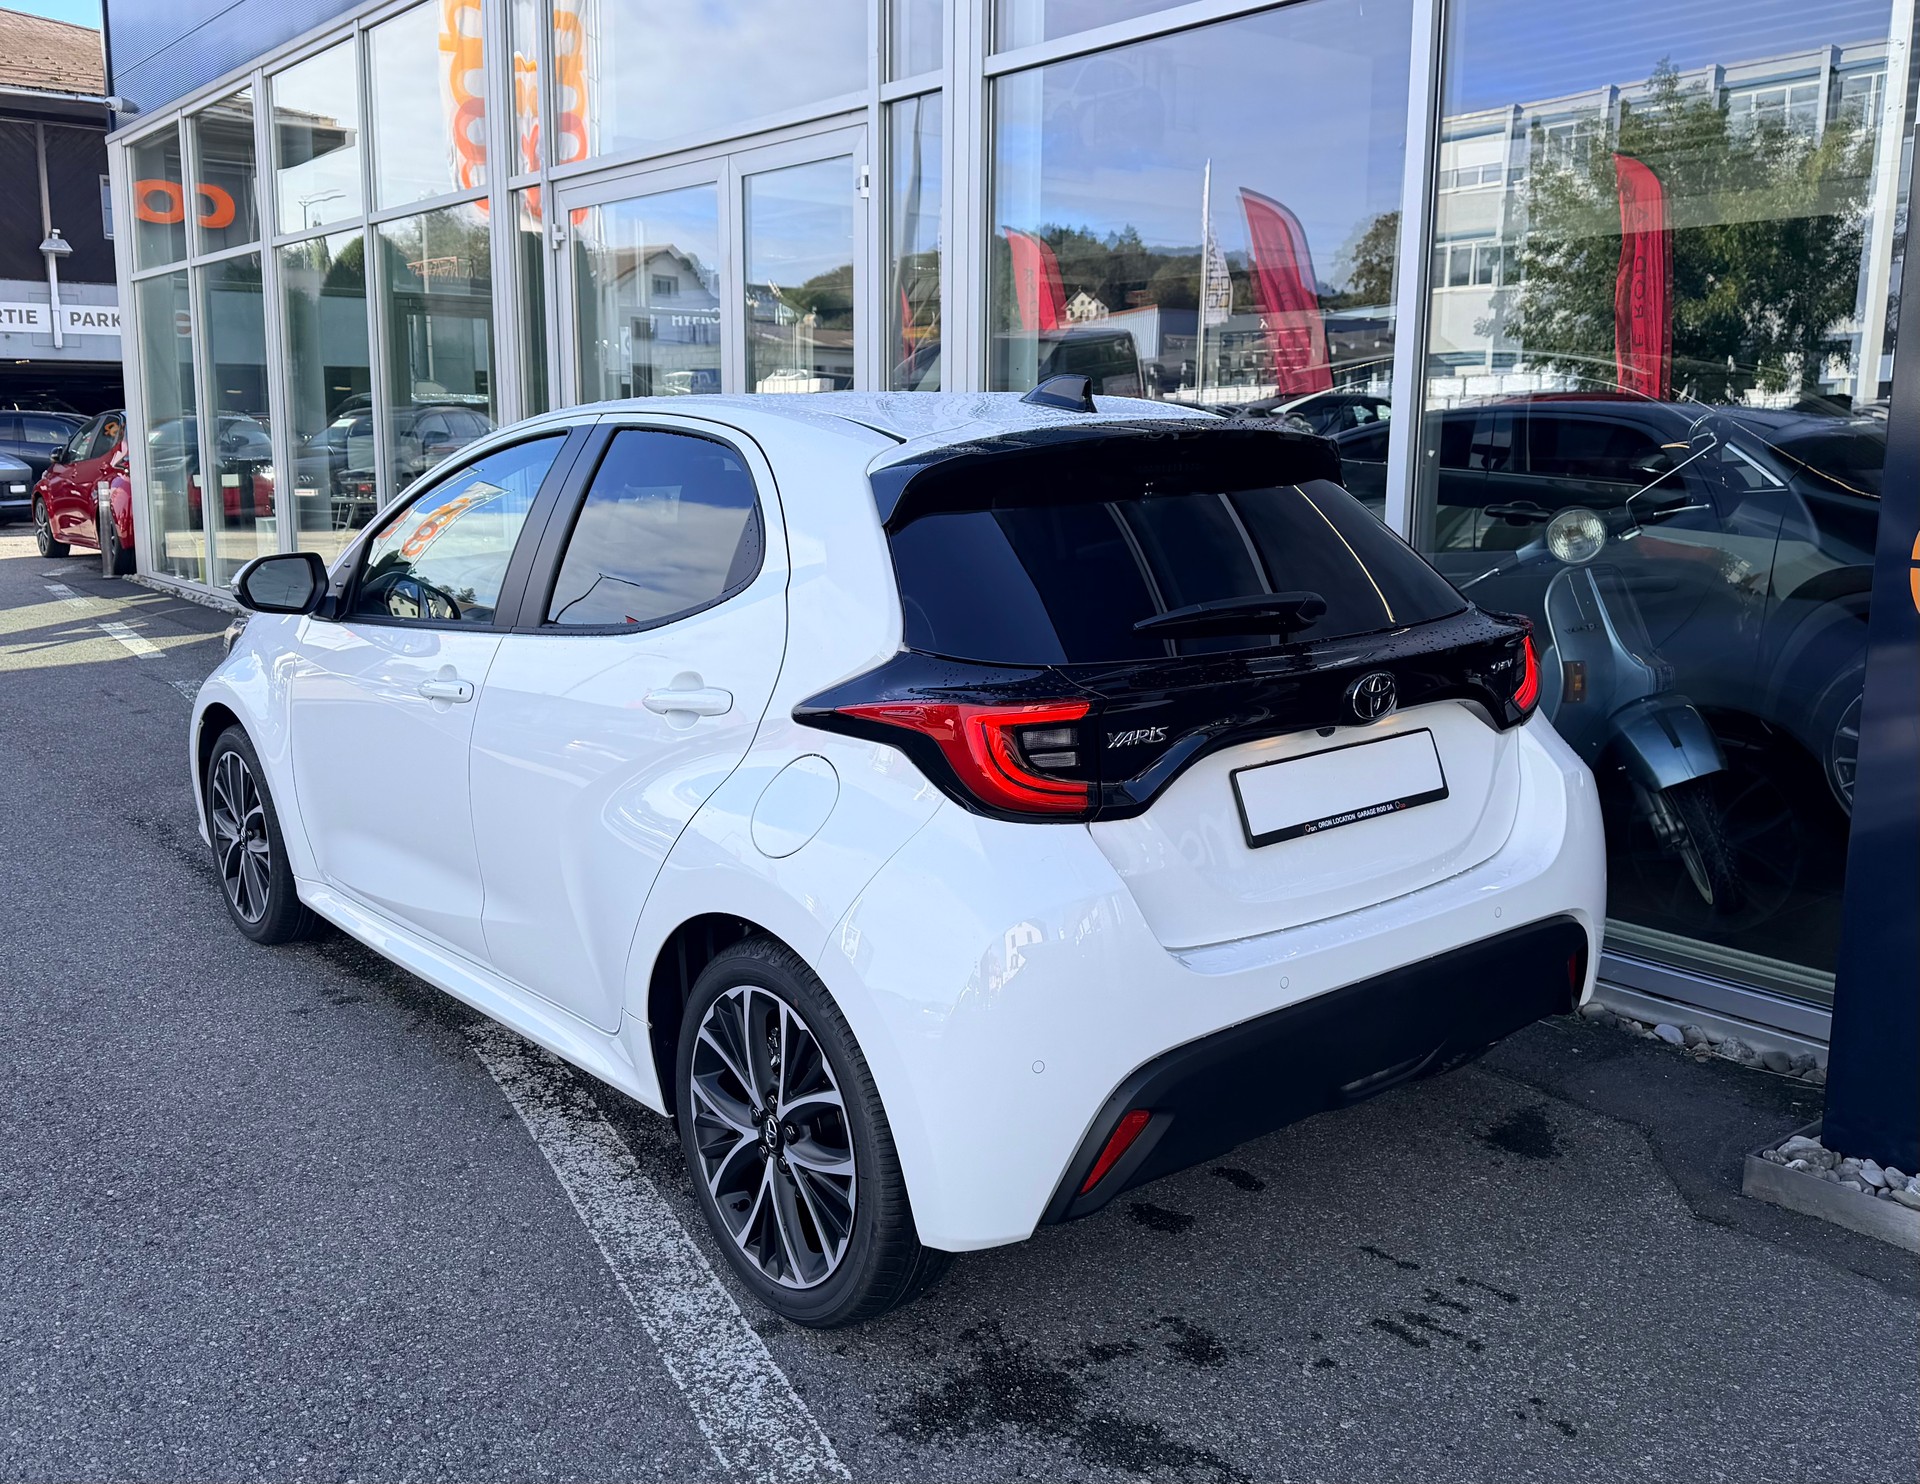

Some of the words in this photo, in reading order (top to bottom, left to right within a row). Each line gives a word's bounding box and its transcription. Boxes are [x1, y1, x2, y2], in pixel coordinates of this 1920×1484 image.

[69, 311, 120, 328] PARK
[1107, 726, 1169, 749] YARIS
[1332, 813, 1357, 825] LOCATION
[1356, 807, 1377, 819] GARAGE
